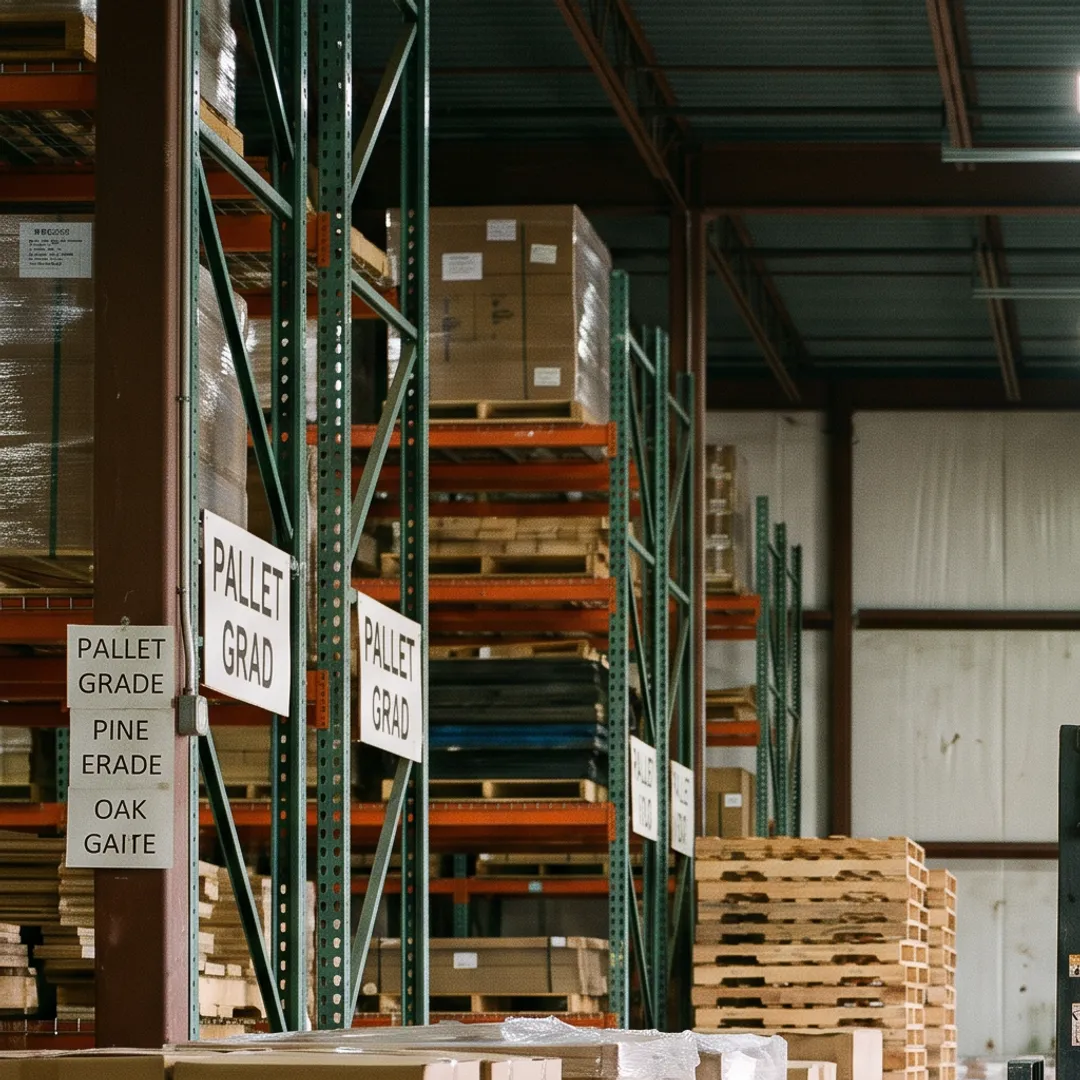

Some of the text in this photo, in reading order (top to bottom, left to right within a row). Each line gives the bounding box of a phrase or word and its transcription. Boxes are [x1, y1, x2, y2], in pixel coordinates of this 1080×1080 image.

[213, 536, 284, 621] PALLET
[78, 638, 166, 660] PALLET
[222, 619, 274, 689] GRAD
[364, 615, 416, 683] PALLET
[78, 673, 164, 695] GRADE
[372, 685, 410, 741] GRAD
[93, 719, 149, 741] PINE
[82, 754, 162, 775] ERADE
[94, 798, 147, 820] OAK
